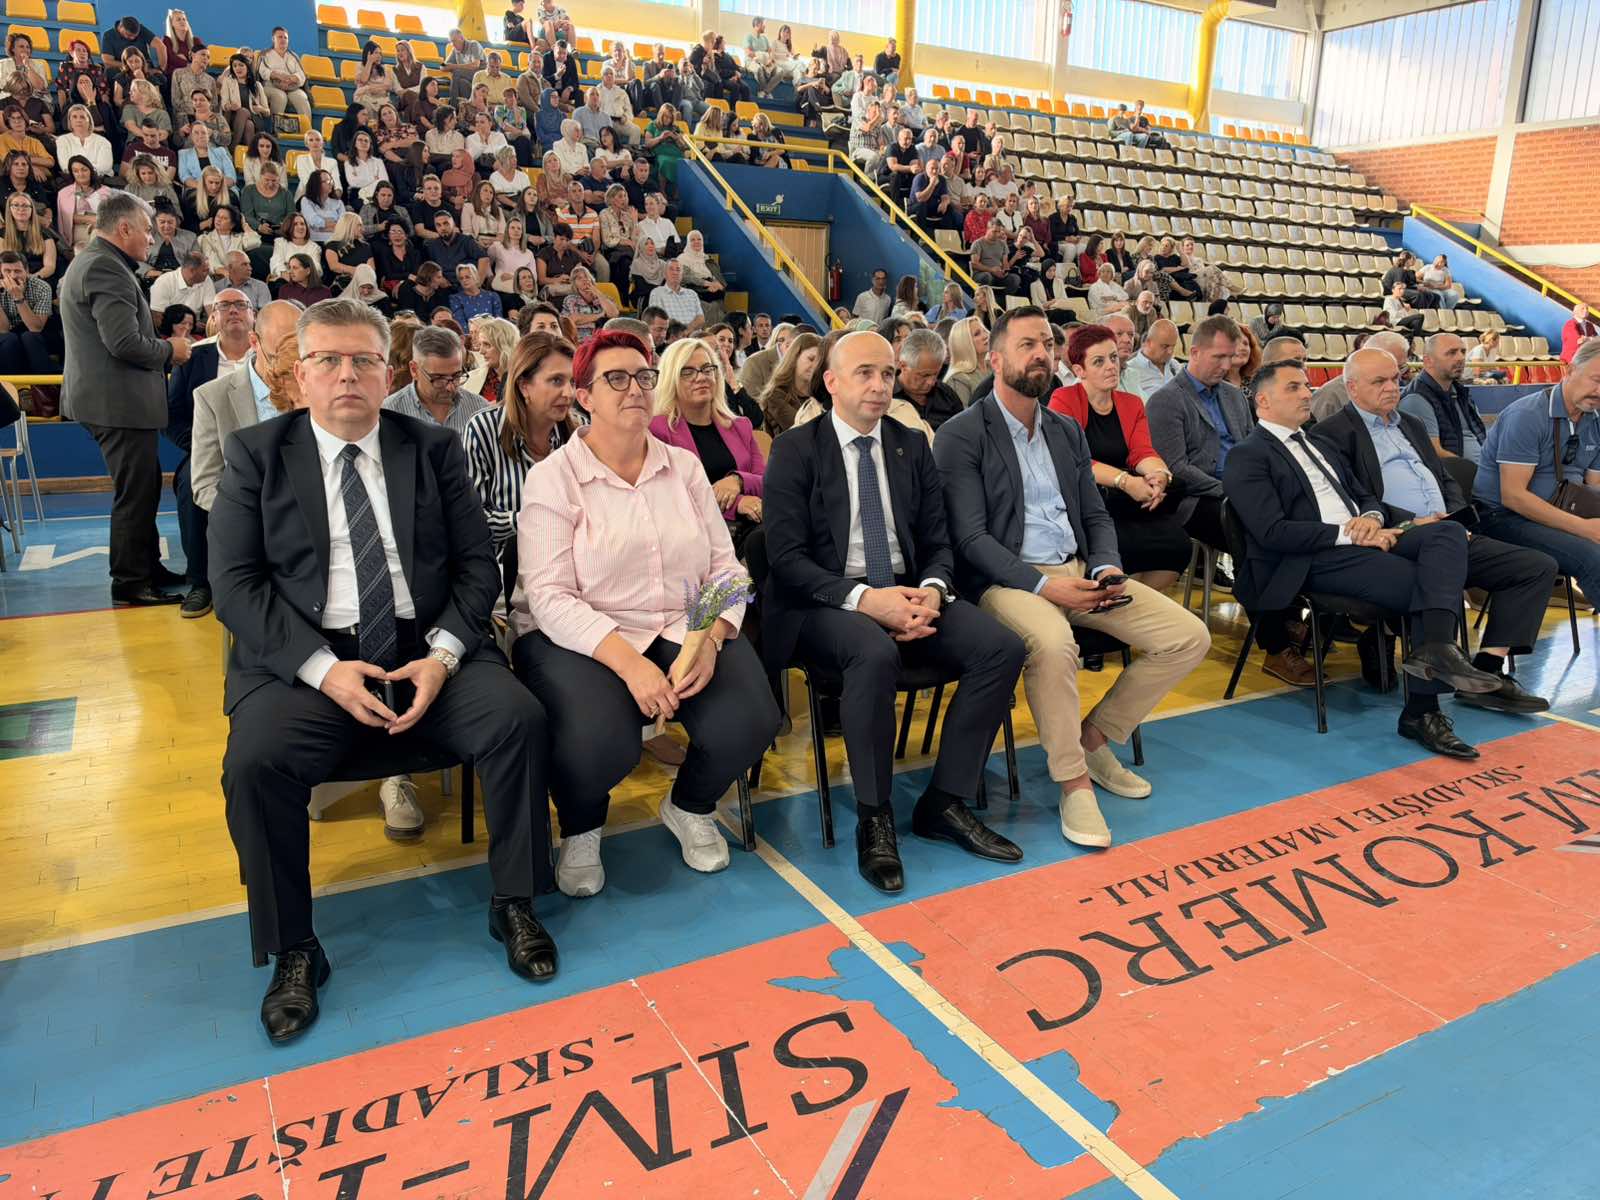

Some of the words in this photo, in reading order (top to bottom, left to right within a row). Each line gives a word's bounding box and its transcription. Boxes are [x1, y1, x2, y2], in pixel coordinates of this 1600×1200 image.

[1333, 816, 1361, 833] I
[1353, 766, 1523, 825] SKLADIŠTE
[996, 769, 1600, 1031] M-KOMERC
[1102, 823, 1339, 907] MATERIJALI
[146, 1036, 595, 1200] SKLADIŠTE
